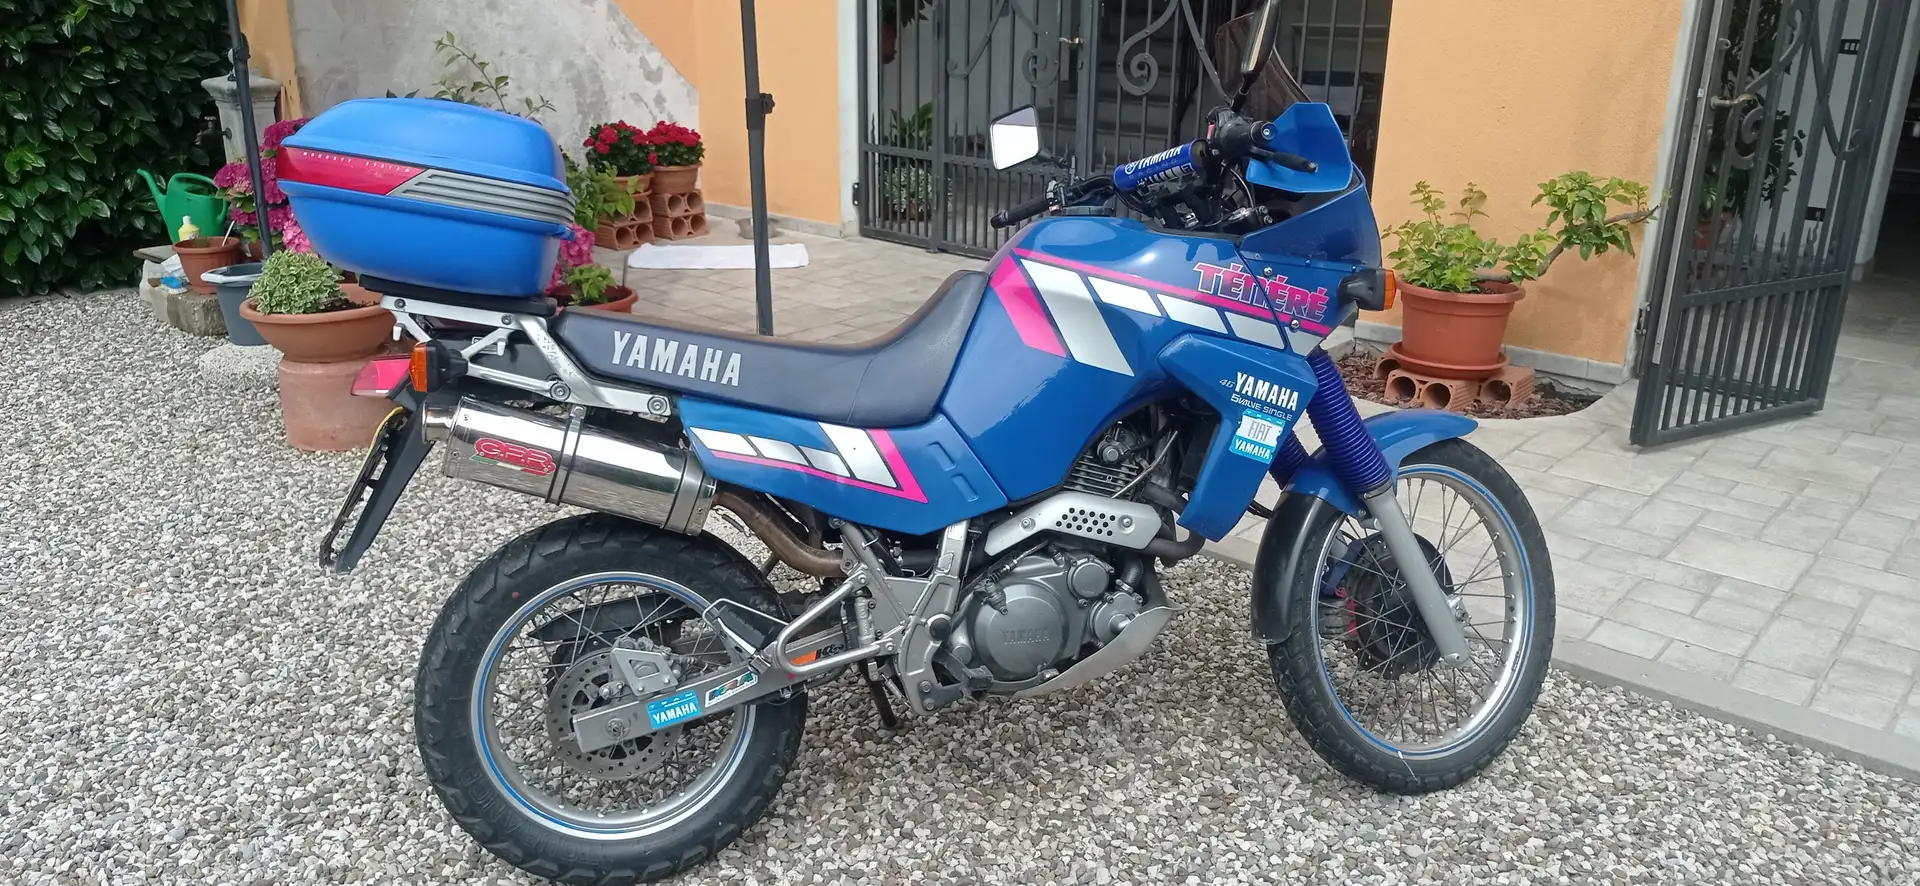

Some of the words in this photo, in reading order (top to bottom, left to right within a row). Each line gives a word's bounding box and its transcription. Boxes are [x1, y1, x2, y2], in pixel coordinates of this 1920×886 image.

[1193, 262, 1329, 323] TÉNÉRÉ
[612, 330, 742, 387] YAMAHA
[1234, 371, 1299, 411] YAMAHA
[1262, 406, 1293, 422] SINGLE
[1247, 420, 1272, 442] FIAT
[1234, 438, 1271, 460] YAMAHA
[652, 702, 698, 724] YAMAHA
